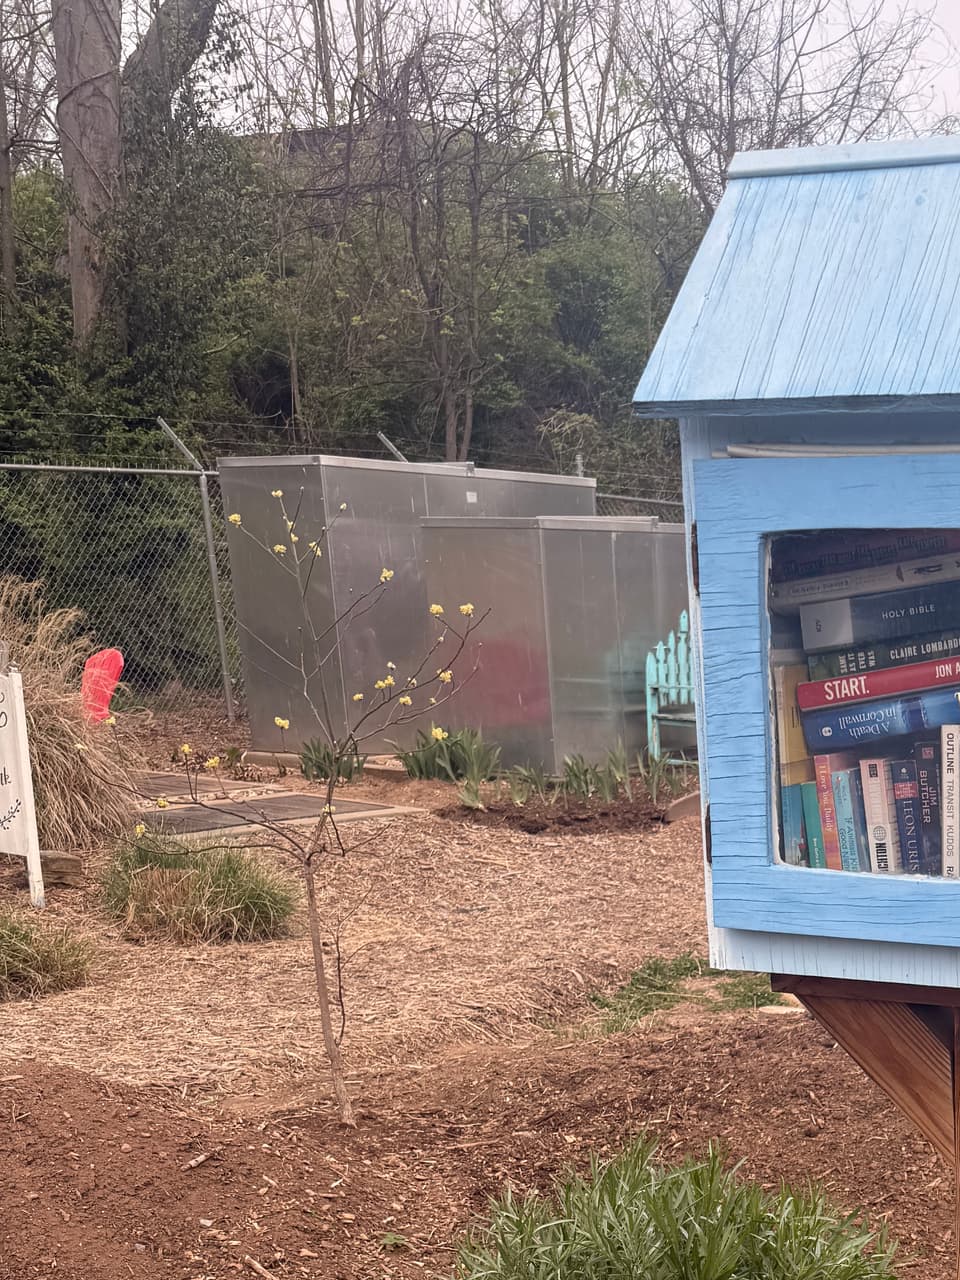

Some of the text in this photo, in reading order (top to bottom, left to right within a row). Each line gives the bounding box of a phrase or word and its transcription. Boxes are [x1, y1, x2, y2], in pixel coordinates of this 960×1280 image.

[882, 604, 935, 620] HOLY BIBLE
[890, 646, 918, 660] CLAIRE
[824, 676, 870, 701] START.
[935, 664, 952, 679] JON
[838, 707, 897, 730] in Cornwall
[849, 722, 890, 740] A Death
[946, 733, 955, 774] OUTLINE
[920, 770, 931, 823] BUTCHER
[929, 787, 938, 806] JIM
[947, 779, 955, 820] TRANSIT
[903, 800, 915, 836] LEON
[907, 841, 919, 872] URIS
[947, 825, 955, 857] KUDOS
